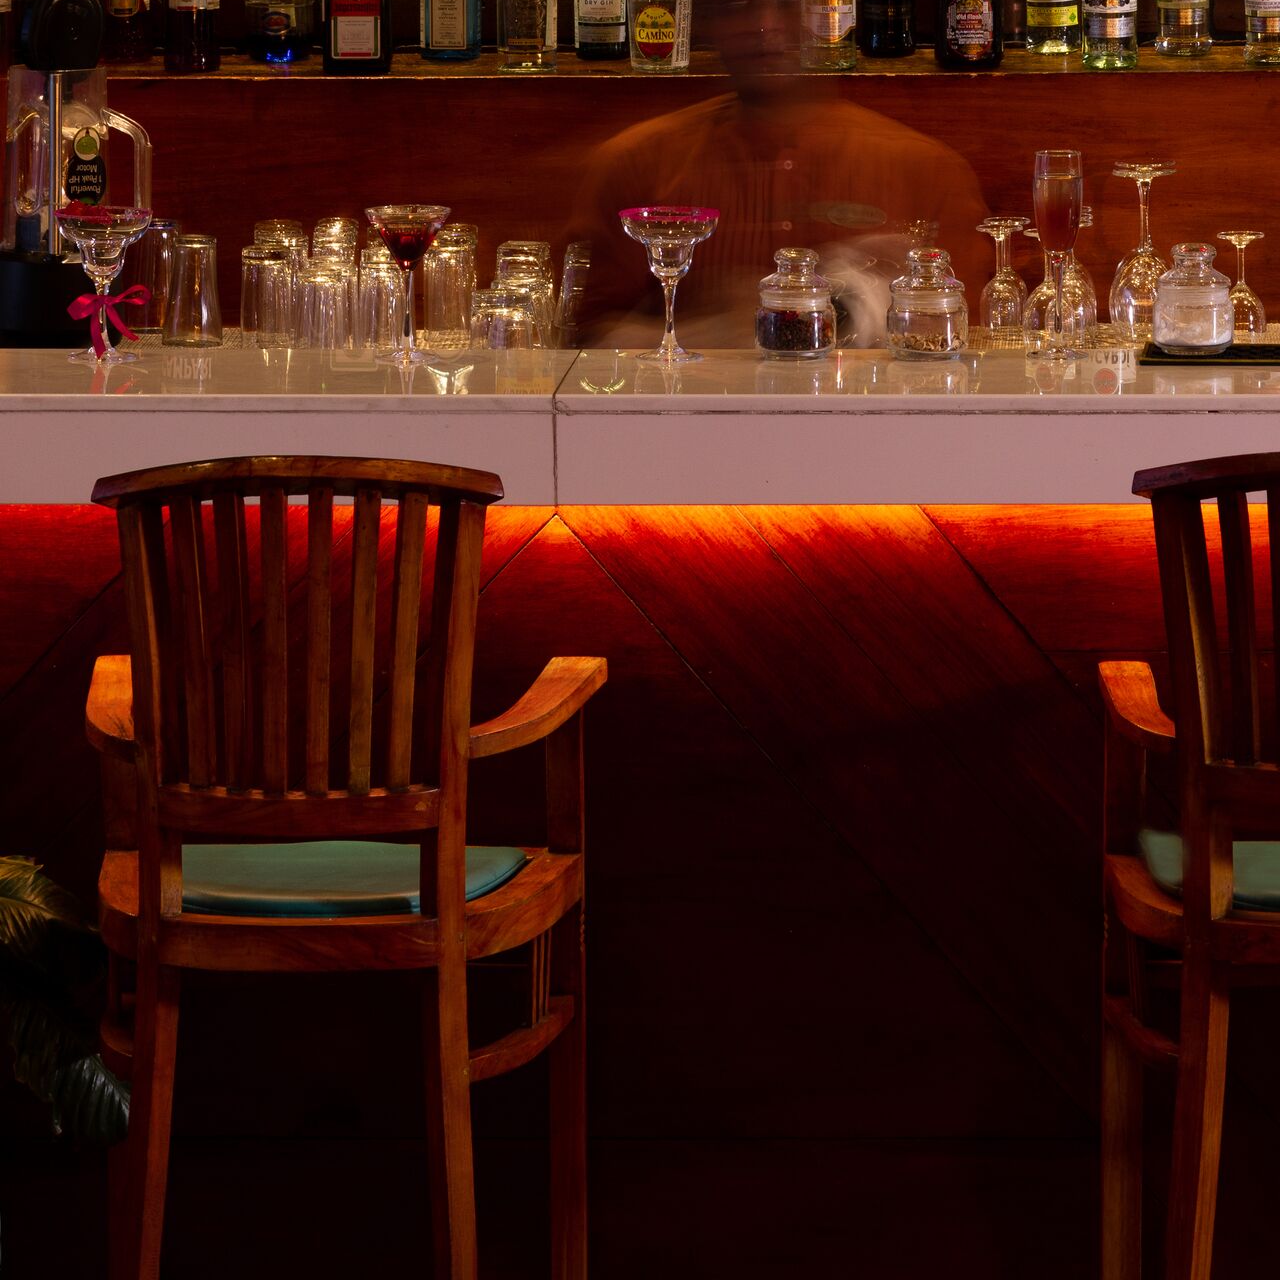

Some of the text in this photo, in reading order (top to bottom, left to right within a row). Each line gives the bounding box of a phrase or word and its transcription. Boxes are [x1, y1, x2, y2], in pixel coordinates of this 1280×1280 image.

[75, 163, 98, 173] Motor
[68, 175, 81, 184] HP
[81, 175, 98, 183] Peak
[70, 184, 101, 194] Powerful
